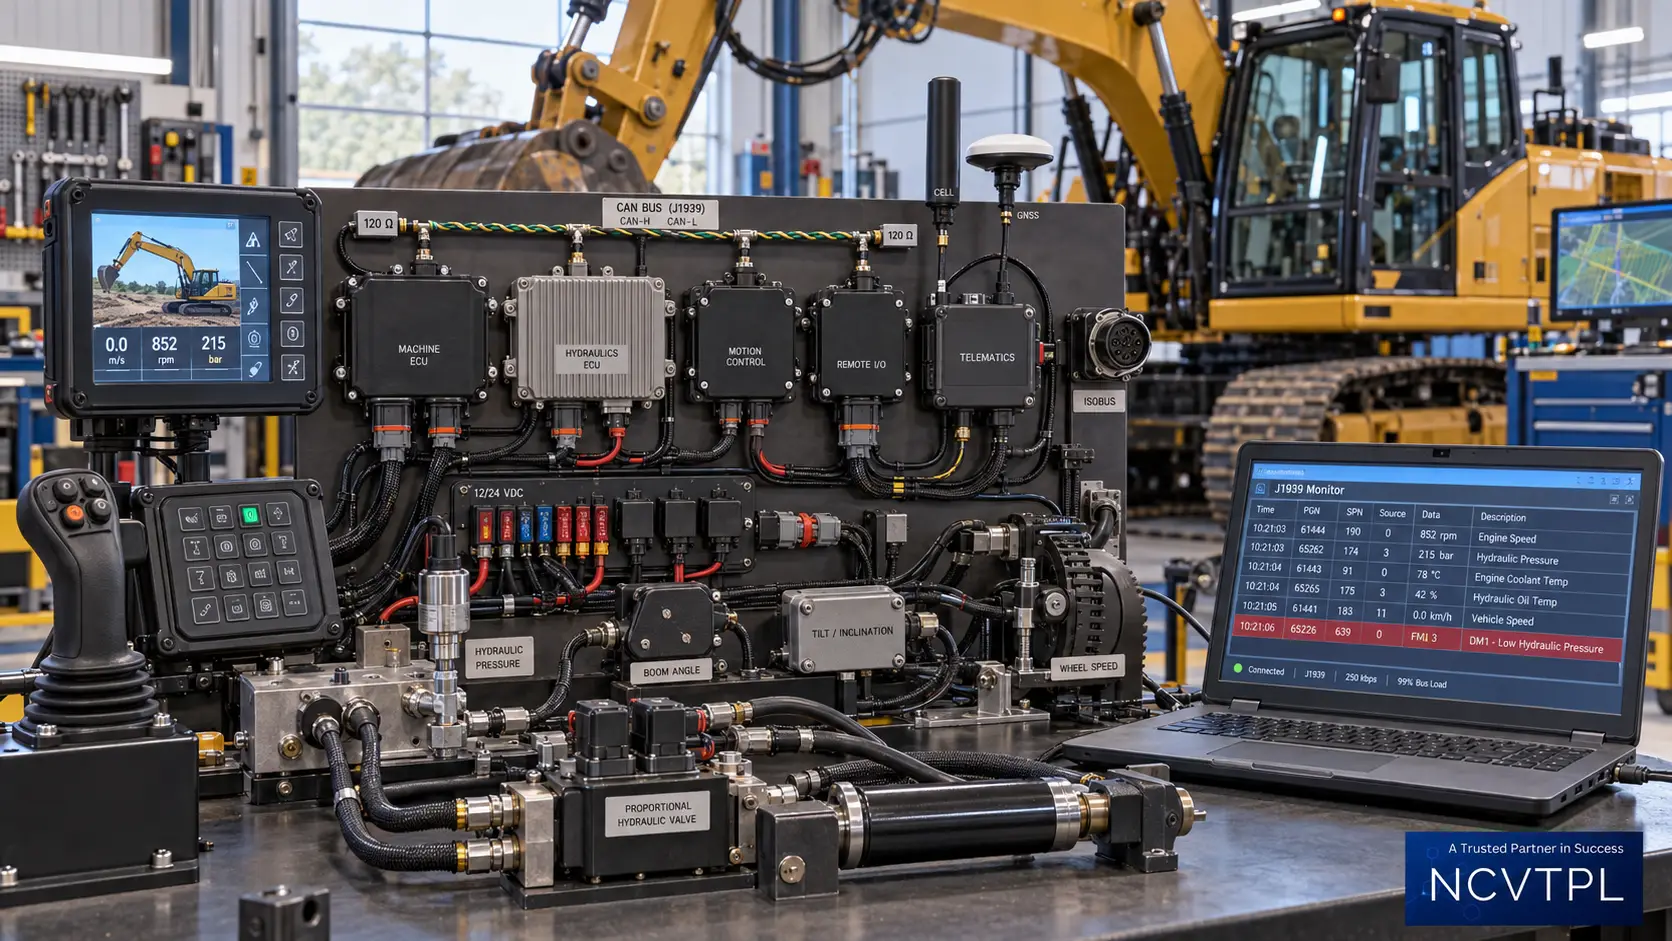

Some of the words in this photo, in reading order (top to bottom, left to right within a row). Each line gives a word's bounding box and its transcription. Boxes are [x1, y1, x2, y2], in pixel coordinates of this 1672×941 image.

[934, 188, 954, 196] CELL
[616, 202, 637, 214] CAN
[641, 202, 662, 213] BUS
[668, 201, 707, 215] (J1939)
[1017, 210, 1039, 219] GNSS
[364, 217, 382, 229] 120
[384, 218, 393, 229] Ω
[620, 217, 650, 226] CAN-H
[667, 217, 697, 226] CAN-L
[888, 231, 902, 241] 120
[903, 231, 913, 241] Ω
[106, 337, 127, 352] 0.0
[152, 337, 177, 351] 852
[202, 336, 226, 350] 215
[398, 344, 440, 354] MACHINE
[566, 349, 618, 359] HYDRAULICS
[729, 347, 762, 356] MOTION
[109, 356, 125, 365] m/s
[158, 357, 174, 366] rpm
[209, 354, 222, 364] bar
[410, 356, 427, 366] ECU
[726, 357, 766, 367] CONTROL
[960, 352, 1015, 362] TELEMATICS
[584, 360, 600, 370] ECU
[837, 359, 871, 369] REMOTE
[874, 359, 886, 369] I/O
[1084, 397, 1116, 407] ISOBUS
[475, 488, 499, 498] 12/24
[504, 488, 524, 498] VDC
[1275, 484, 1304, 494] J1939
[1306, 485, 1344, 495] Monitor
[1257, 505, 1275, 514] Time
[1304, 507, 1320, 515] PGN
[1347, 508, 1363, 516] SPN
[1379, 509, 1406, 518] Source
[1422, 510, 1440, 519] Data
[1481, 512, 1526, 523] Description
[1301, 525, 1325, 534] 61444
[1346, 527, 1361, 536] 190
[1385, 529, 1391, 537] 0
[1420, 530, 1436, 539] 852
[1440, 533, 1457, 541] rpm
[1479, 532, 1507, 543] Engine
[1510, 534, 1537, 544] Speed
[1344, 547, 1359, 555] 174
[1383, 548, 1389, 557] 3
[1419, 550, 1435, 559] 215
[1439, 550, 1454, 560] bar
[1477, 553, 1518, 564] Hydraulic
[1520, 555, 1559, 565] Pressure
[1297, 564, 1321, 573] 61443
[1343, 567, 1352, 575] 91
[1382, 568, 1387, 576] 0
[1417, 569, 1427, 579] 78
[1475, 571, 1504, 584] Engine
[1507, 573, 1540, 585] Coolant
[1543, 576, 1568, 588] Temp
[1340, 586, 1355, 595] 175
[1380, 588, 1385, 597] 3
[1415, 590, 1426, 599] 42
[1430, 590, 1438, 600] %
[1473, 592, 1515, 606] Hydraulic
[1518, 595, 1529, 606] Oil
[1531, 596, 1557, 608] Temp
[1243, 602, 1277, 611] 10:21:05
[1293, 604, 1317, 613] 61441
[1338, 607, 1353, 615] 183
[1377, 609, 1386, 618] 11
[1413, 611, 1426, 620] 0.0
[1430, 611, 1452, 622] km/h
[1472, 613, 1503, 625] Vehicle
[1507, 615, 1534, 628] Speed
[812, 629, 829, 638] TILT
[832, 628, 837, 638] /
[839, 625, 894, 638] INCLINATION
[1240, 622, 1275, 631] 10:21:06
[1335, 627, 1351, 636] 639
[1377, 630, 1382, 638] 0
[1431, 634, 1437, 642] 3
[1469, 636, 1489, 646] DM1
[1498, 638, 1516, 648] Low
[1519, 639, 1561, 652] Hydraulic
[1564, 642, 1604, 654] Pressure
[475, 646, 523, 656] HYDRAULIC
[476, 660, 520, 669] PRESSURE
[1059, 662, 1087, 673] WHEEL
[1088, 662, 1118, 672] SPEED
[644, 666, 668, 677] BOOM
[671, 665, 700, 676] ANGLE
[1248, 666, 1284, 676] Connected
[1305, 670, 1325, 679] J1939
[1345, 673, 1359, 681] 250
[1359, 675, 1377, 684] kbps
[1398, 677, 1413, 687] 99%
[1415, 678, 1429, 688] Bus
[1430, 679, 1447, 689] Load
[625, 802, 692, 813] PROPORTIONAL
[618, 815, 666, 827] HYDRAULIC
[669, 814, 696, 825] VALVE
